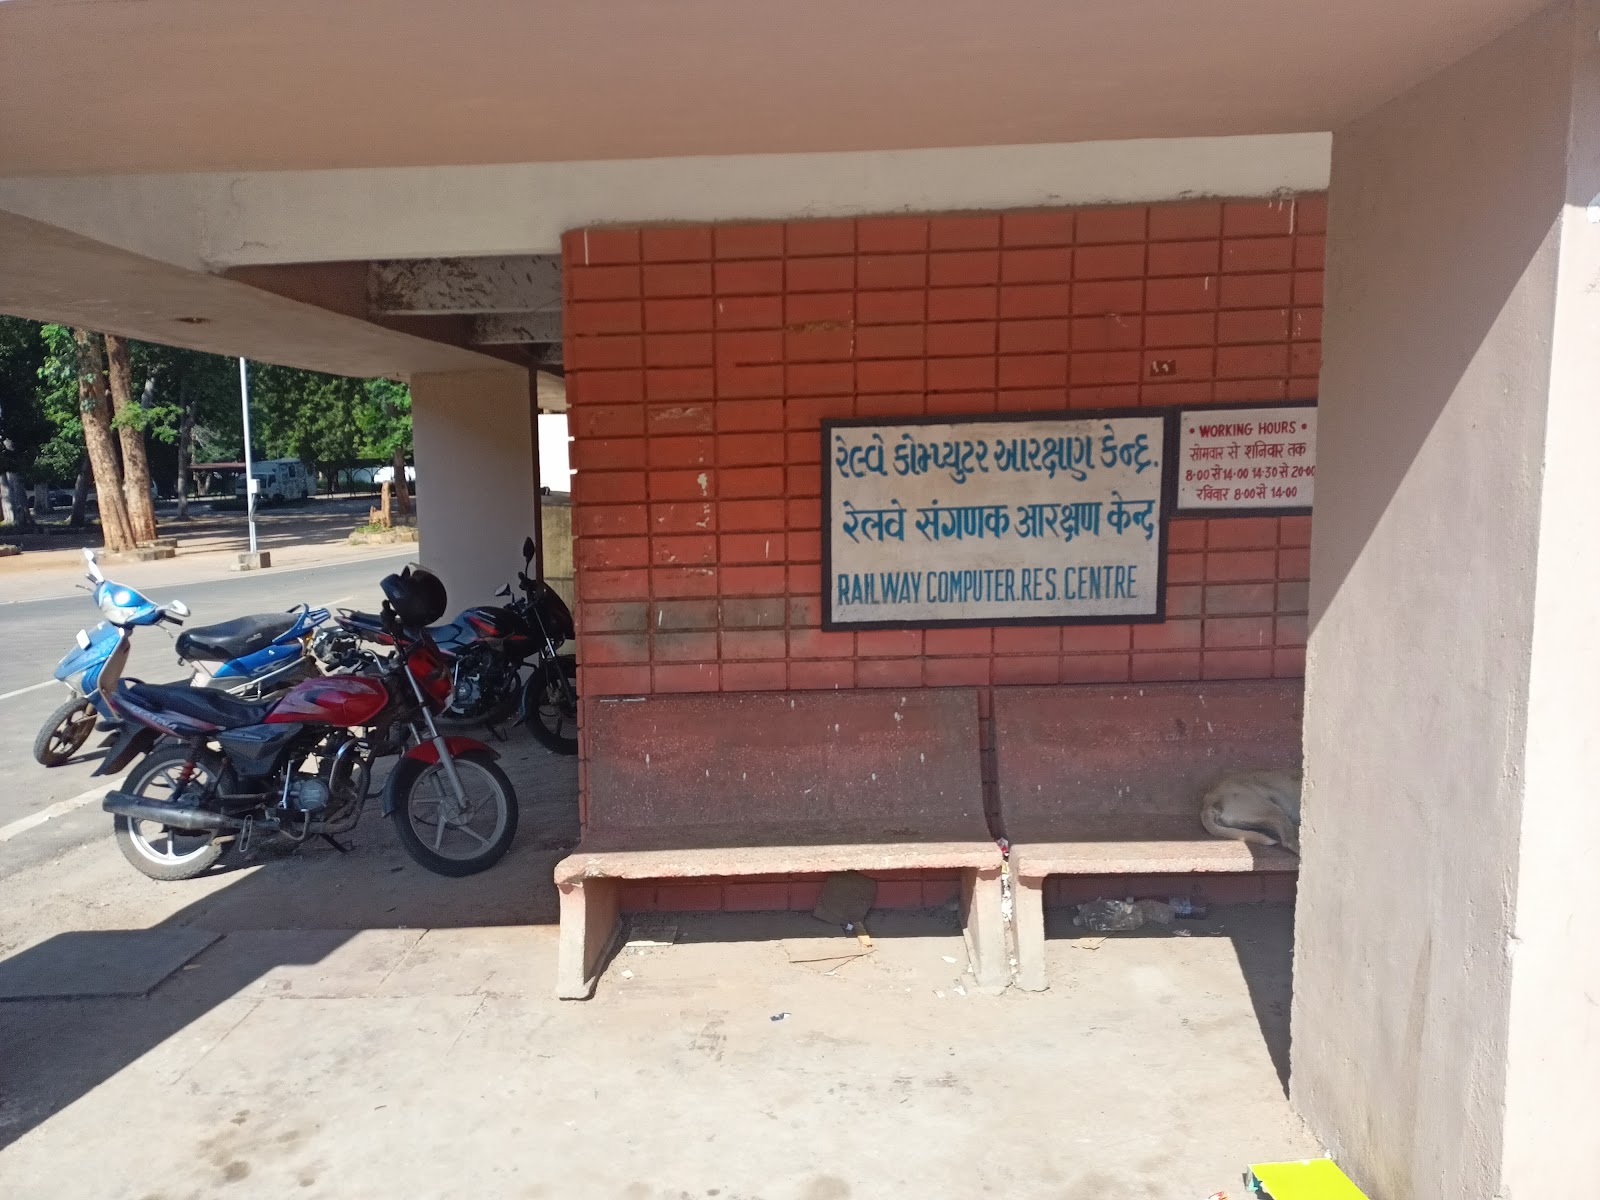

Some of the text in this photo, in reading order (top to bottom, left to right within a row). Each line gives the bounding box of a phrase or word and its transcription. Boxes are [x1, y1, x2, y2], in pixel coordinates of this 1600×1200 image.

[1189, 439, 1307, 461] सोमवार से शनिवार तक
[1198, 420, 1297, 438] WORKING HOURS
[835, 432, 889, 479] રેલ્વે
[842, 498, 908, 545] रेलवे
[914, 498, 1010, 543] संगणक
[1013, 501, 1103, 543] आरक्षण
[837, 571, 923, 607] RAILWAY
[1063, 564, 1138, 601] CENTRE
